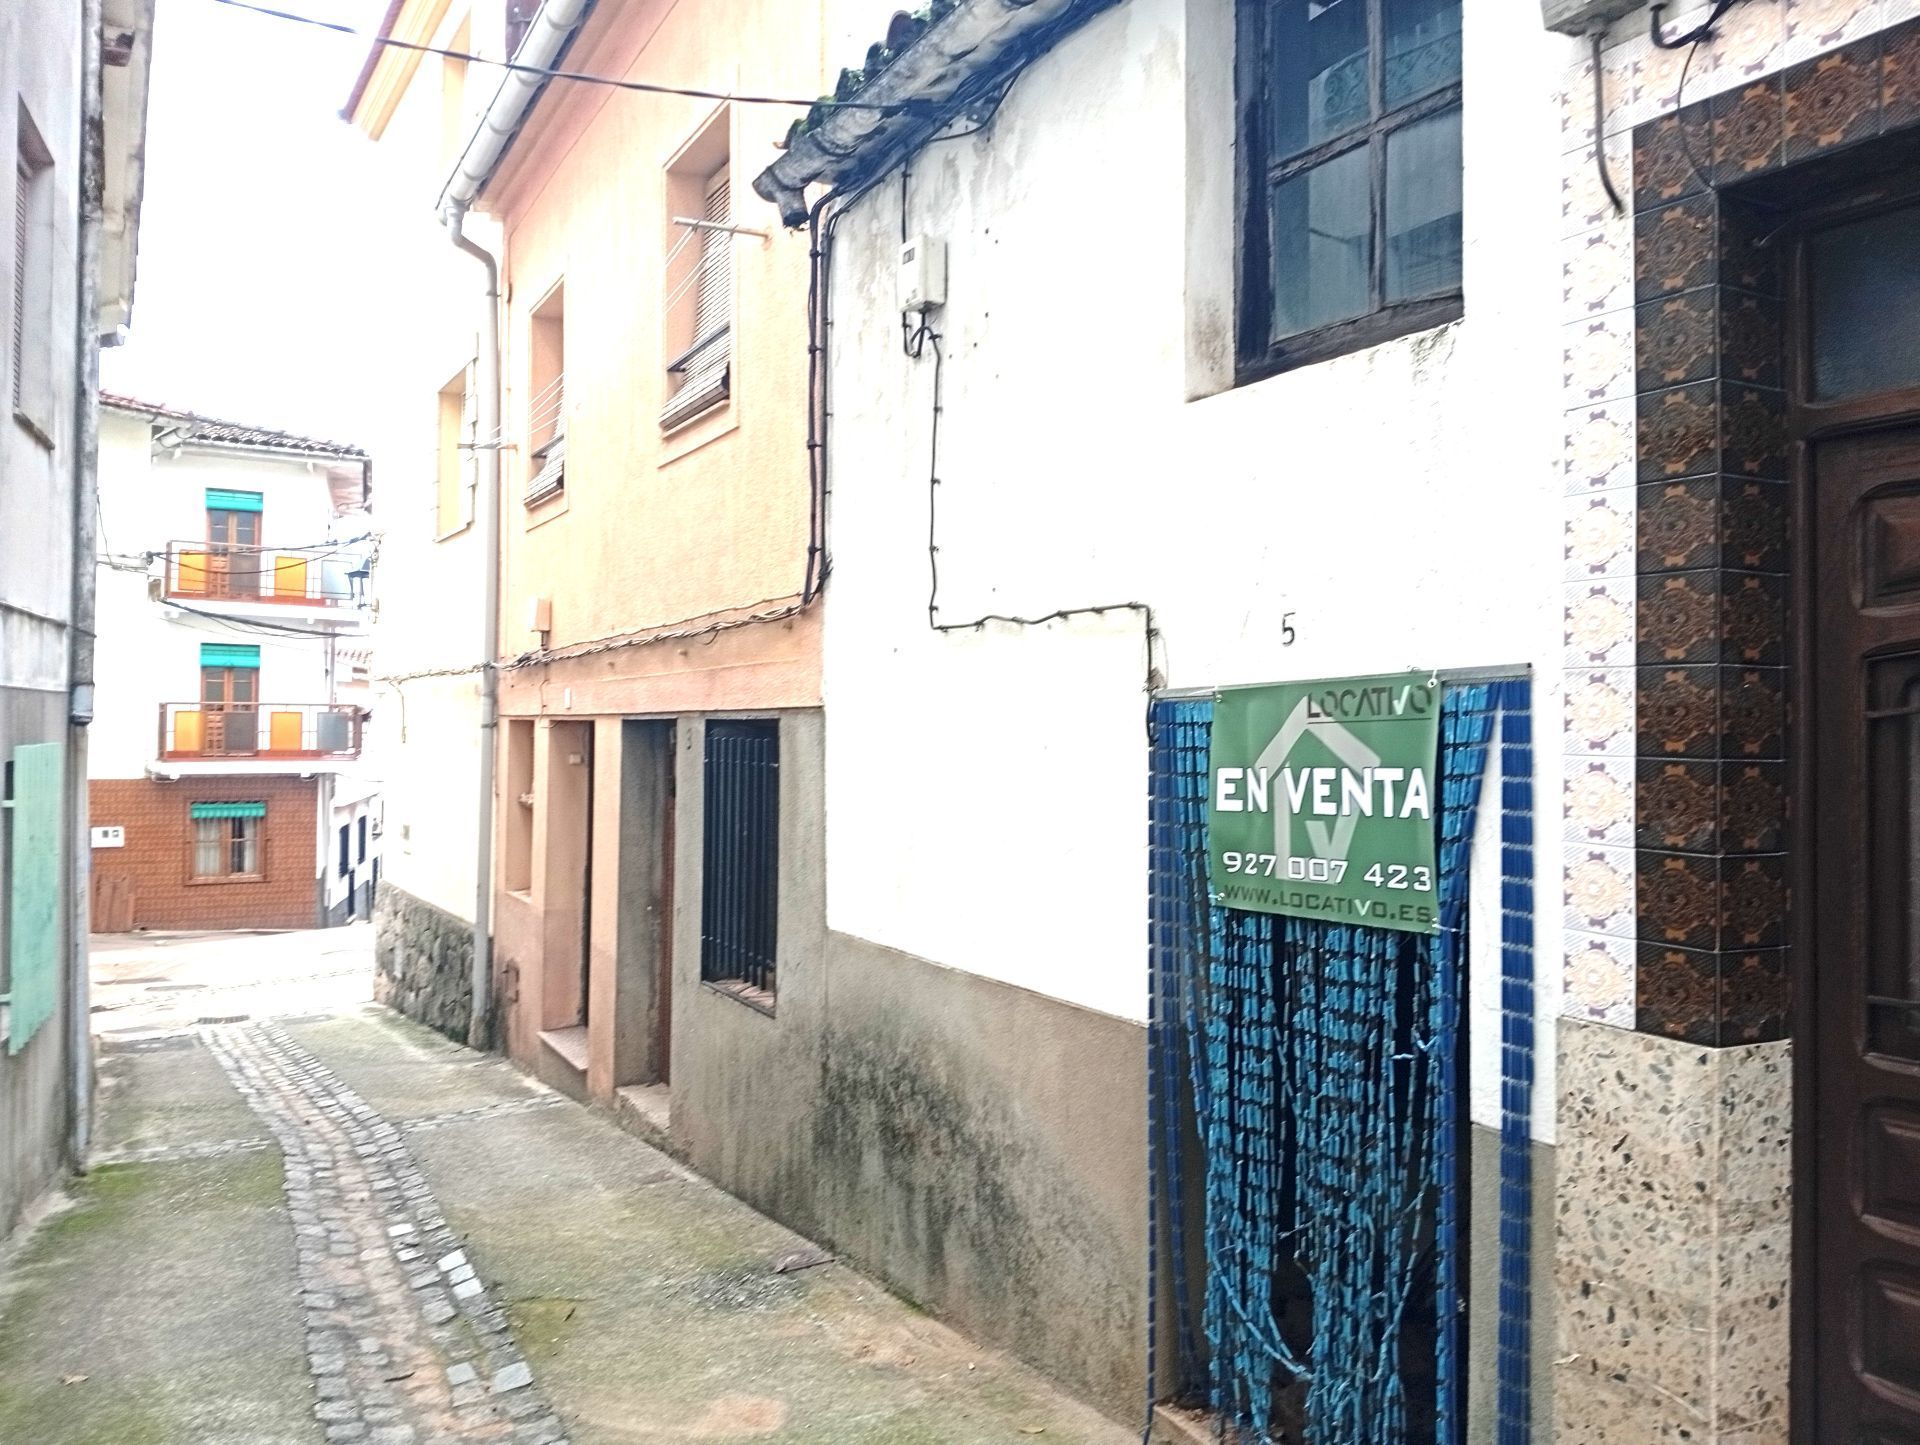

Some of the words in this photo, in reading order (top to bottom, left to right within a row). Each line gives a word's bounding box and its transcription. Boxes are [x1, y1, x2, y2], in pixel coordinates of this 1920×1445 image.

[1282, 611, 1295, 647] 5
[1306, 684, 1432, 718] LOCATIVO
[1216, 767, 1268, 813] EN
[1283, 767, 1430, 820] VENTA
[1222, 851, 1277, 877] 927
[1287, 856, 1349, 884] 007
[1363, 862, 1432, 892] 423
[1224, 884, 1431, 923] WWW.LOCATIVO.ES
